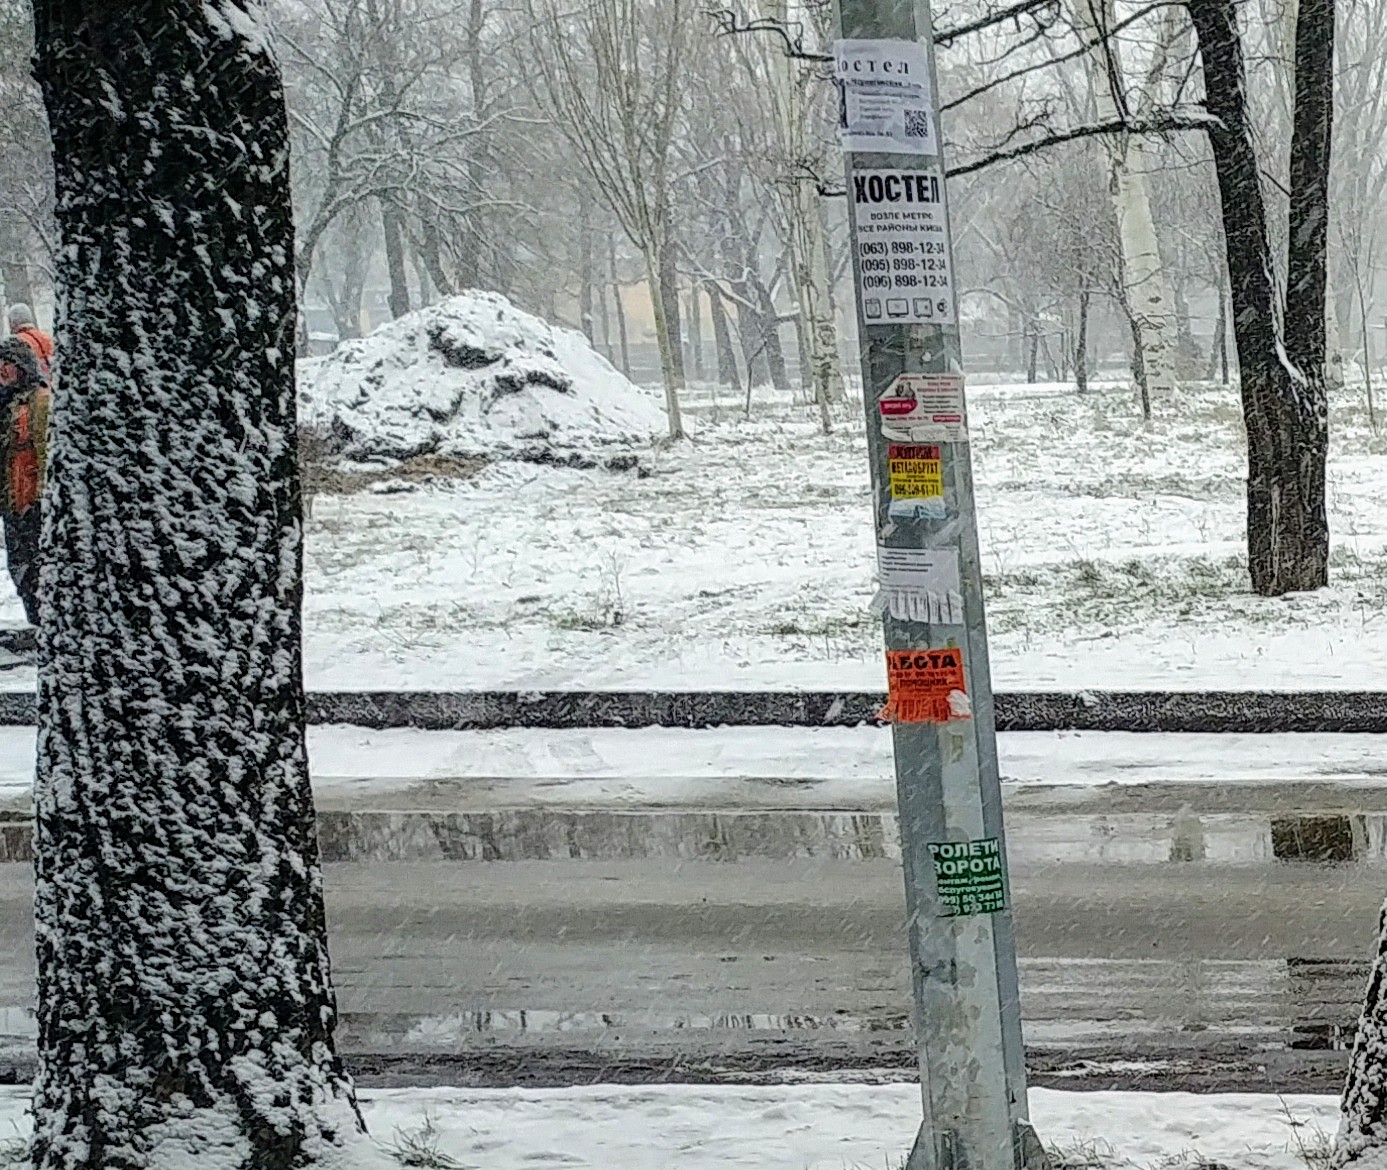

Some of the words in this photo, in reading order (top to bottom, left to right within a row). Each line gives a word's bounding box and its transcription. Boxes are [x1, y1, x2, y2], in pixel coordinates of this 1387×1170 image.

[853, 174, 941, 204] ХОСТЕЛ
[870, 212, 899, 221] ВОЗЛЕ
[876, 223, 918, 232] РАЙОНЫ
[860, 242, 889, 257] (063)
[861, 258, 890, 273] (095)
[927, 840, 998, 858] РОЛЕТИ
